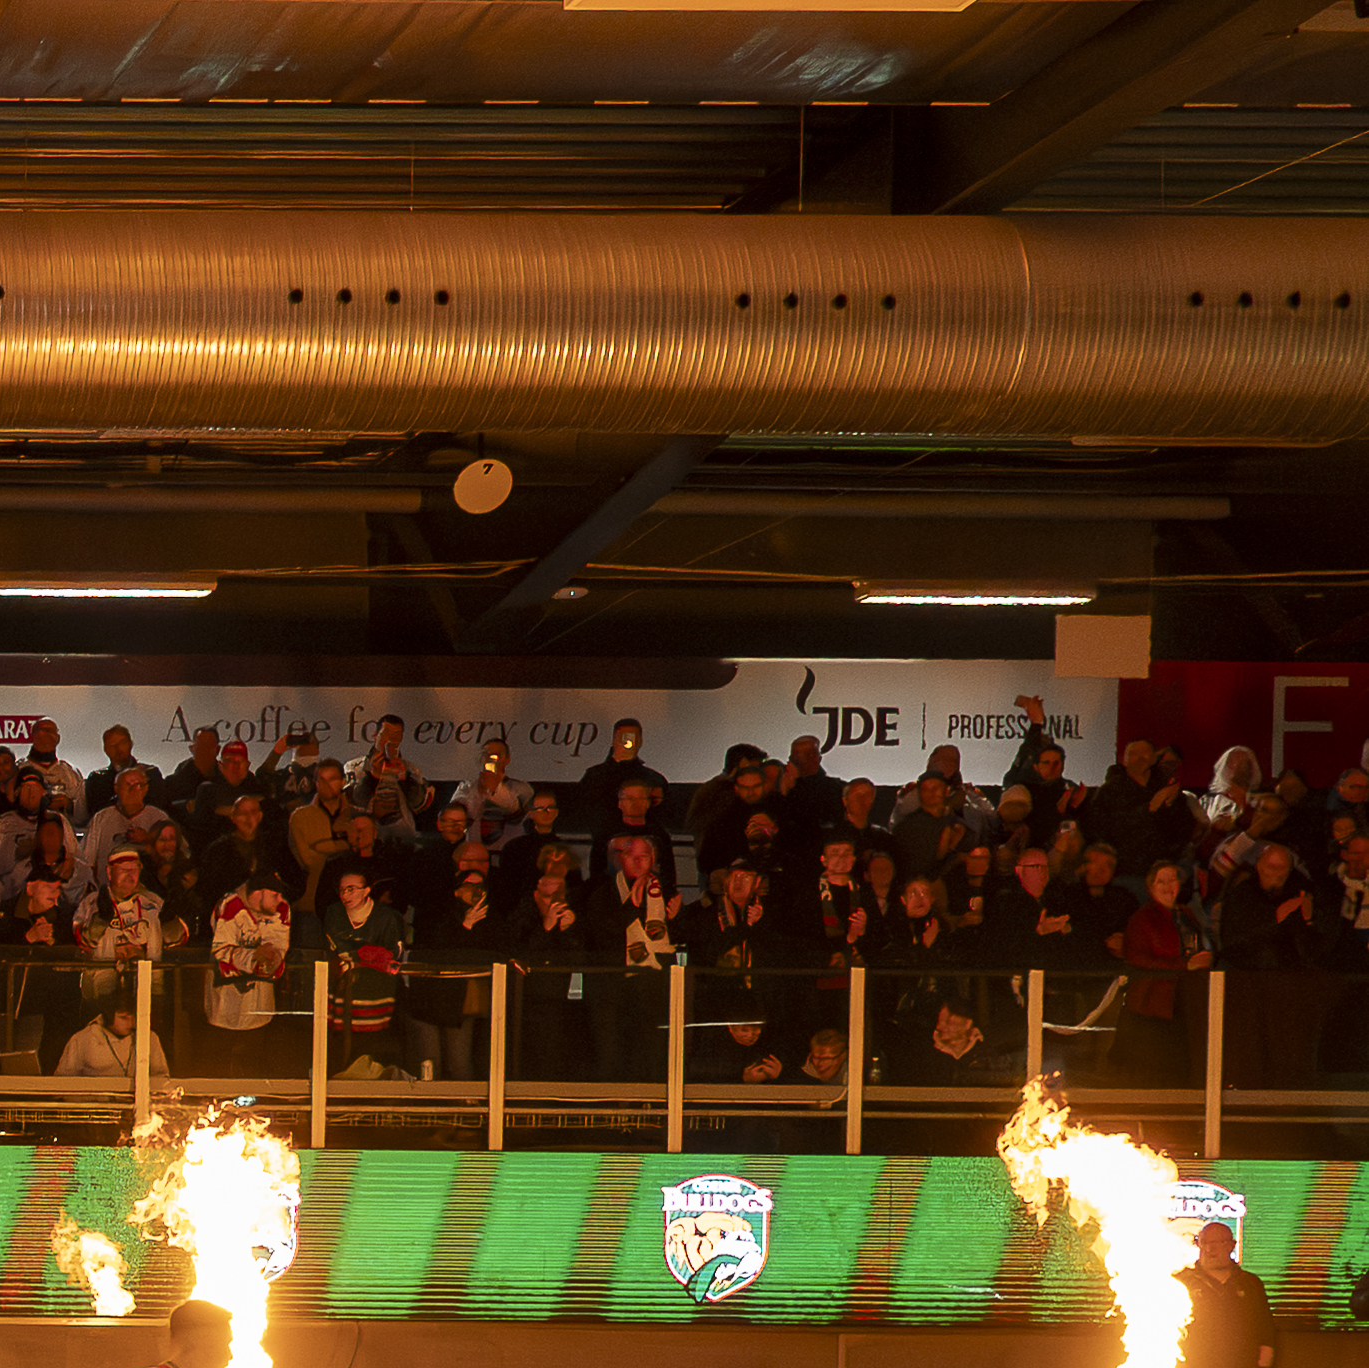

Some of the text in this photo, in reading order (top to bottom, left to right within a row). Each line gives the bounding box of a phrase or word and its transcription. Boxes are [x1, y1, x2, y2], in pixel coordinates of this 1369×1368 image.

[483, 463, 494, 475] 7
[162, 705, 195, 743] A
[528, 719, 600, 758] cup
[811, 707, 900, 755] JDE
